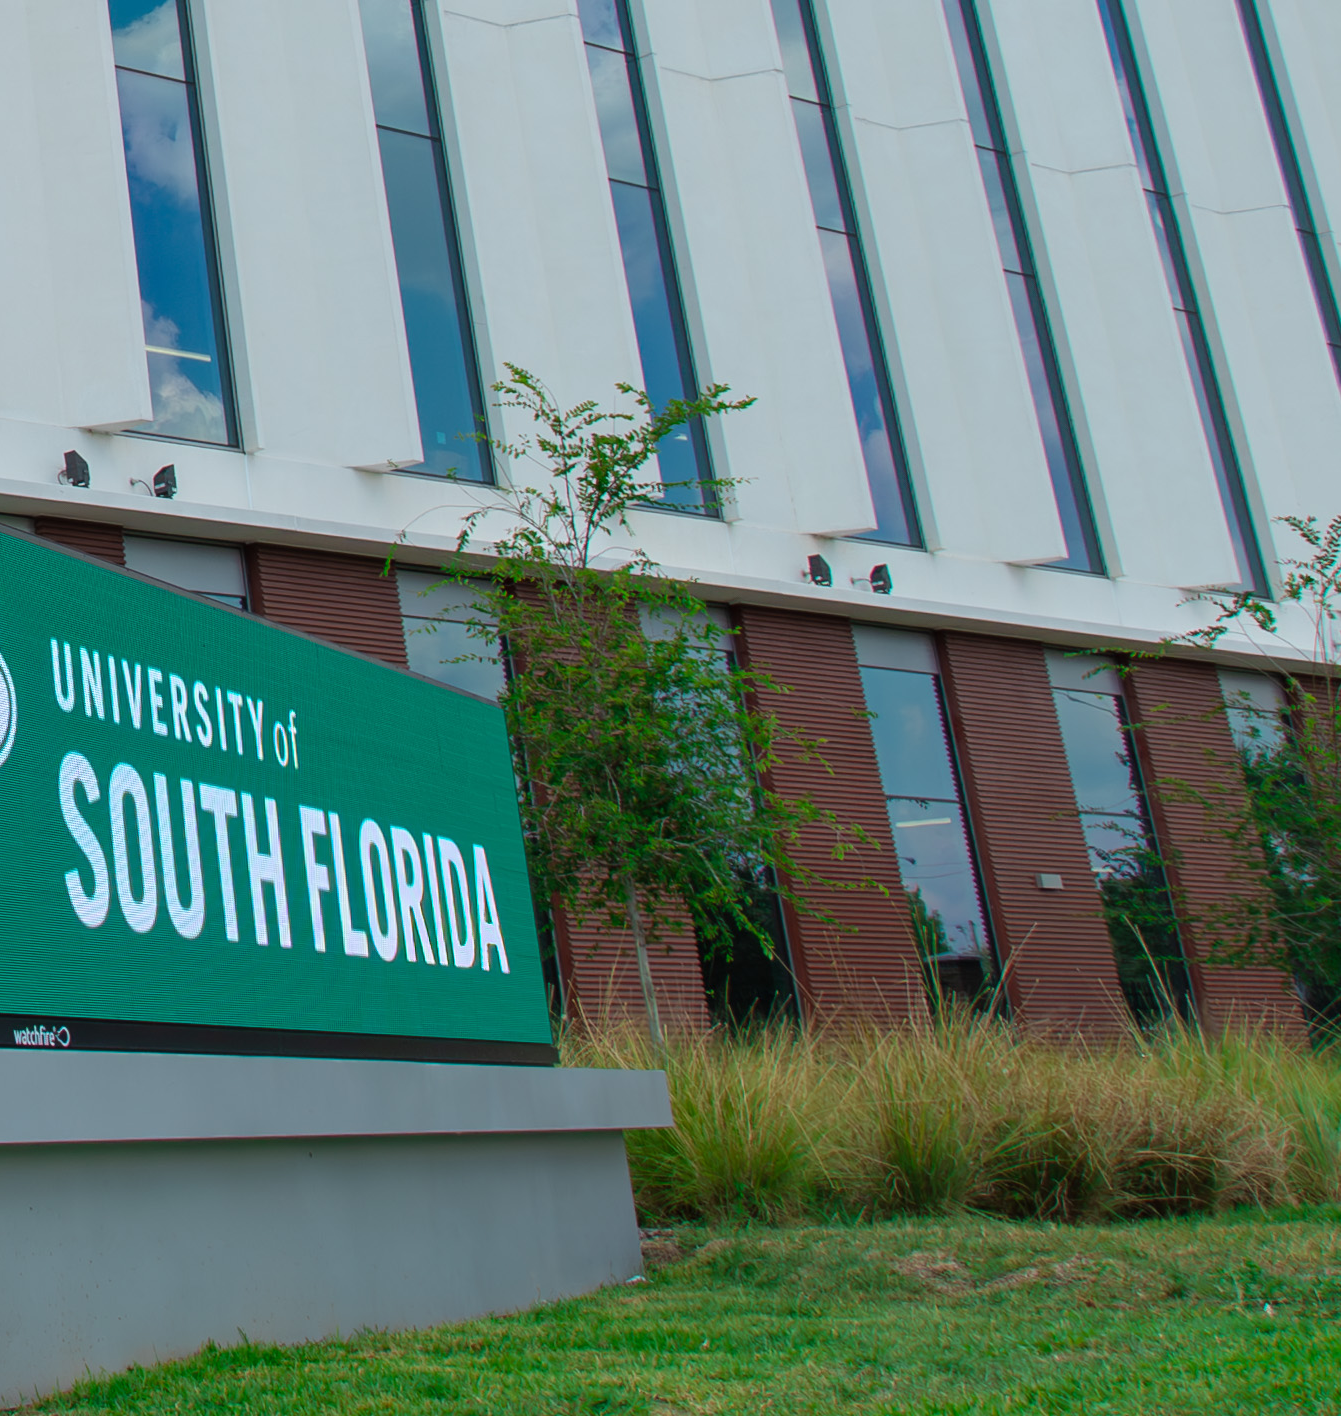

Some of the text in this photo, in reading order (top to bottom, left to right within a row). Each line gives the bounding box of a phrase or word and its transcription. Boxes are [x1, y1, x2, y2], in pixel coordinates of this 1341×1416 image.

[50, 638, 299, 770] UNIVERSITY of
[58, 750, 511, 975] SOUTH FLORIDA
